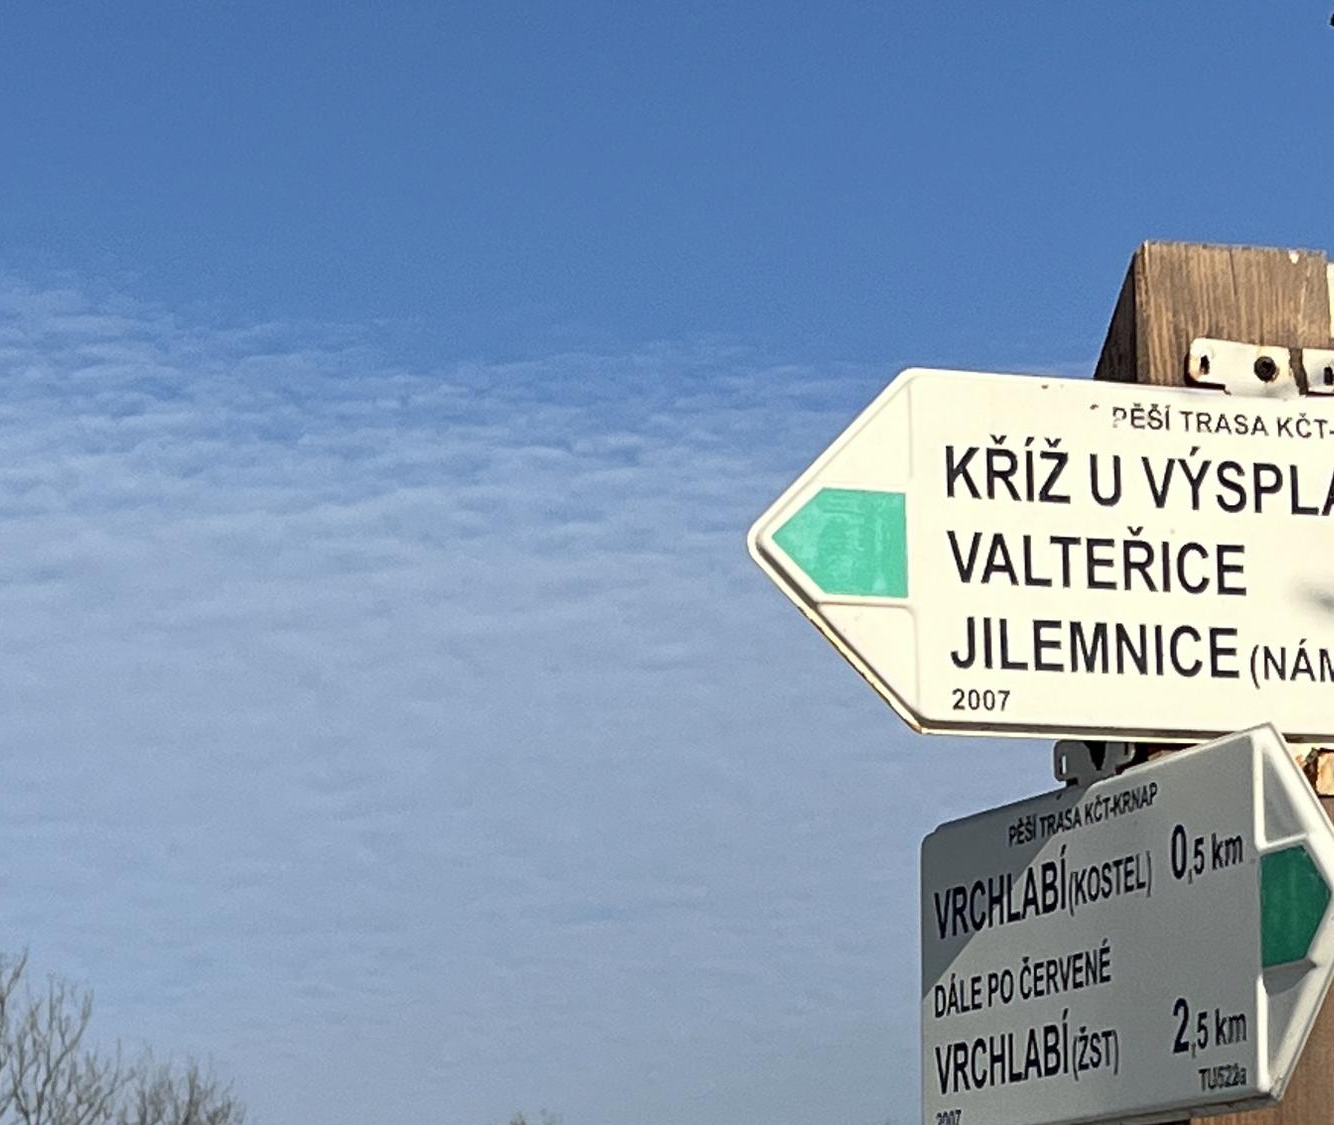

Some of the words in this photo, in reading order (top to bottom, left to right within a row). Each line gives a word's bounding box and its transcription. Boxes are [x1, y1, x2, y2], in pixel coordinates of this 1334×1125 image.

[1179, 409, 1268, 438] TRASA
[944, 436, 1070, 505] KŘÍŽ
[1089, 454, 1123, 507] U
[947, 526, 1247, 596] VALTEŘICE
[951, 616, 1240, 680] JILEMNICE
[952, 689, 1010, 713] 2007
[1009, 813, 1037, 847] PĚŠÍ
[1039, 803, 1082, 838] TRASA
[1083, 782, 1158, 825] KČT-KRNAP
[1171, 824, 1205, 882] 0,5
[1213, 833, 1244, 867] km
[934, 970, 982, 1018] DÁLE
[988, 970, 1014, 1004] PO
[1019, 937, 1111, 998] ČERVENÉ
[1173, 998, 1208, 1057] 2,5
[1214, 1008, 1246, 1046] km
